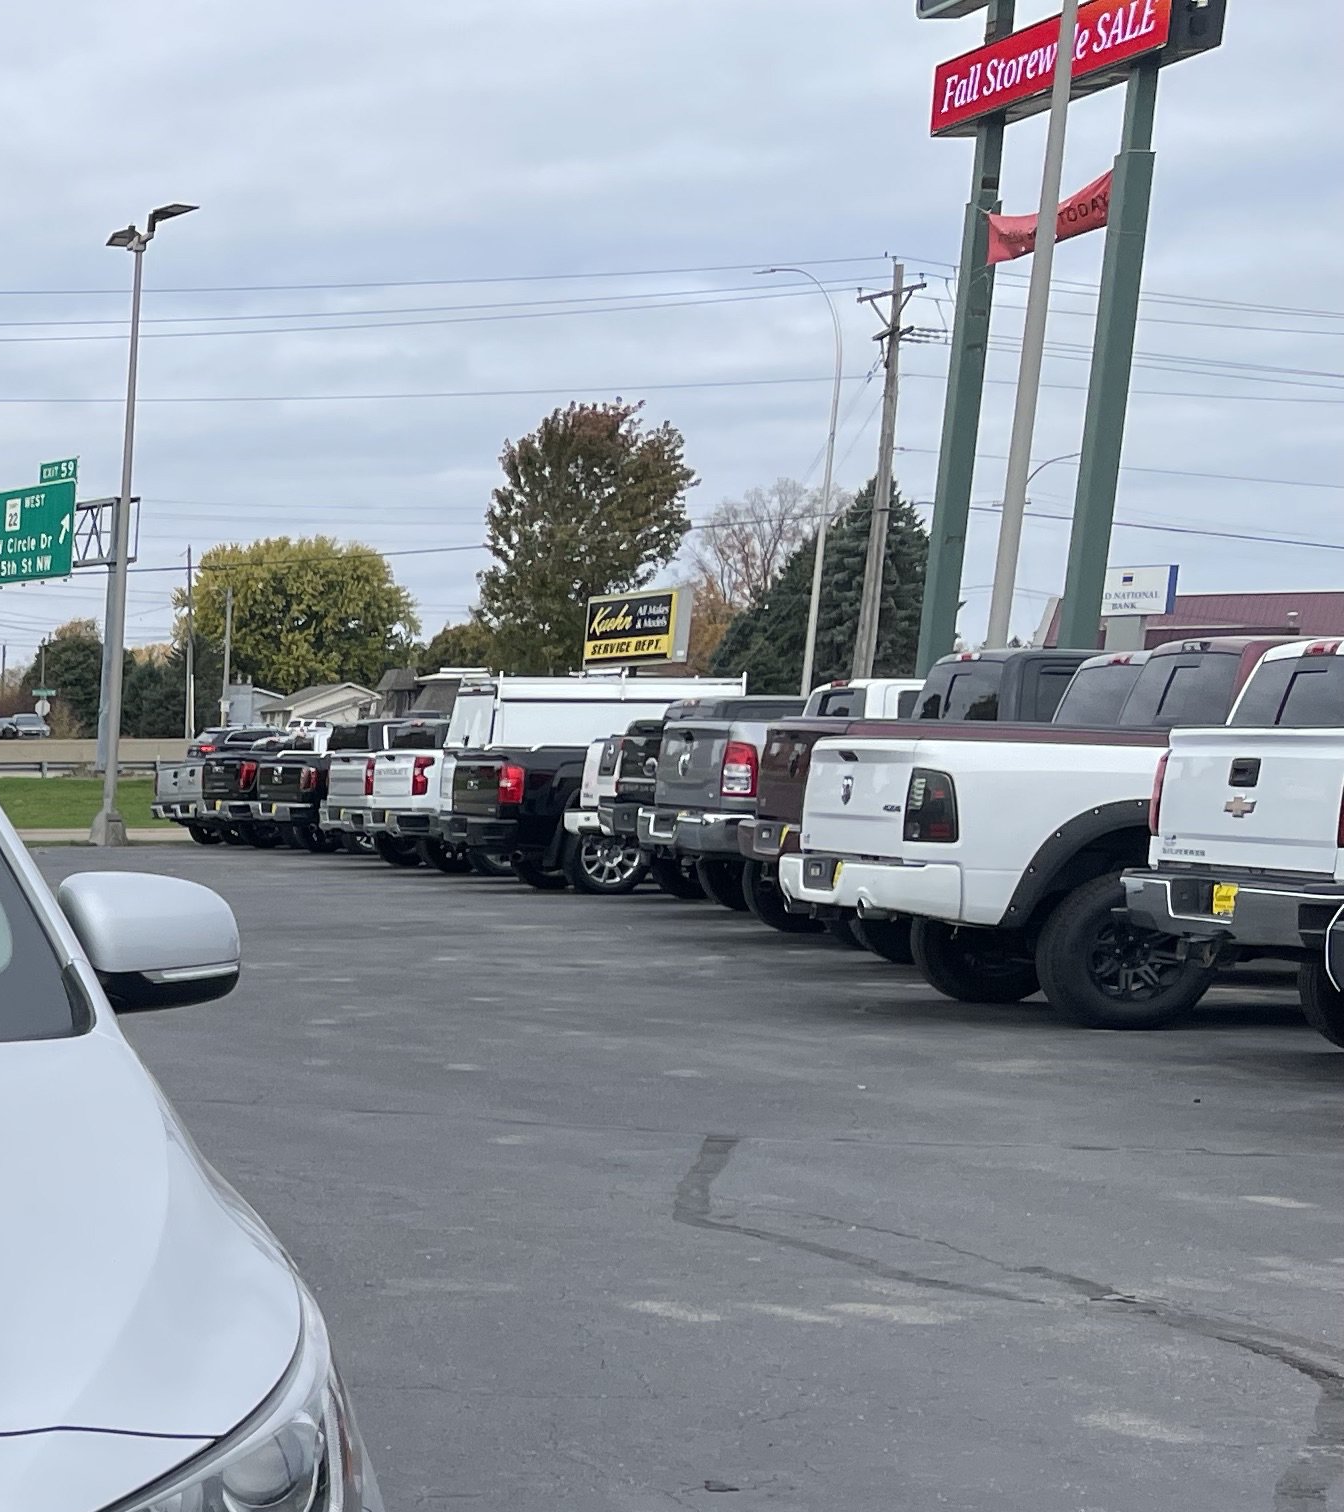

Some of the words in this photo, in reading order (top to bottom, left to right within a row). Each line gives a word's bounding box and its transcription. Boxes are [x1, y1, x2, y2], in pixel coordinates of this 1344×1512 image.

[940, 63, 982, 114] Fall
[983, 23, 1089, 97] Storewe
[1093, 0, 1160, 54] SALE
[1057, 191, 1108, 226] TODAY
[42, 466, 59, 479] EXIT
[60, 461, 75, 478] 59
[24, 493, 46, 509] WEST
[8, 512, 18, 528] 22
[7, 535, 36, 554] Circle
[40, 533, 53, 550] Dr
[21, 557, 32, 573] St
[36, 555, 52, 572] NW
[1113, 590, 1160, 600] NATIONAL
[1111, 602, 1137, 610] BANK
[589, 603, 633, 637] Kuehn
[590, 641, 632, 656] SERVICE
[634, 638, 662, 652] DEPT.
